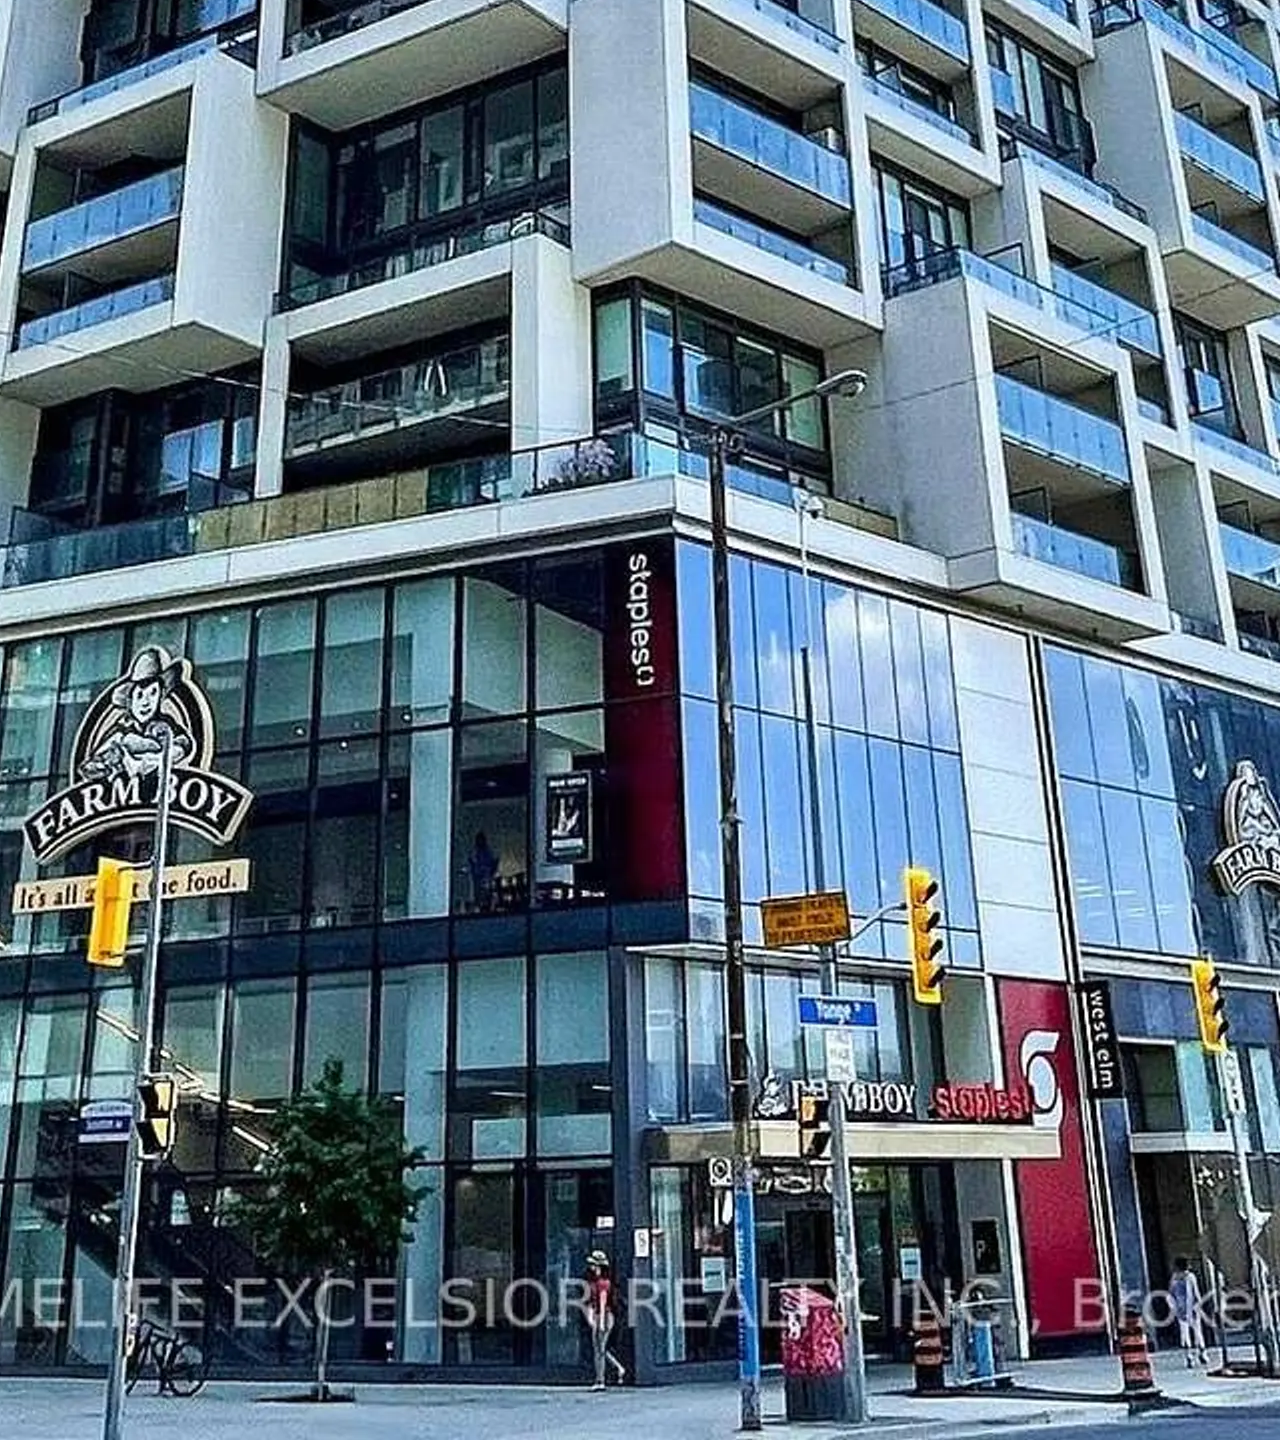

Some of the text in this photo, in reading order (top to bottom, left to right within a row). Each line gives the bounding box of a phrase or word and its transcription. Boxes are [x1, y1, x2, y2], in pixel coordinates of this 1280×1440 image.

[627, 553, 653, 666] staples
[32, 774, 237, 849] FARM BOY
[20, 885, 47, 907] It's
[54, 881, 78, 906] all
[186, 866, 238, 893] food.
[1090, 989, 1114, 1090] west elm
[868, 1081, 915, 1114] BOY
